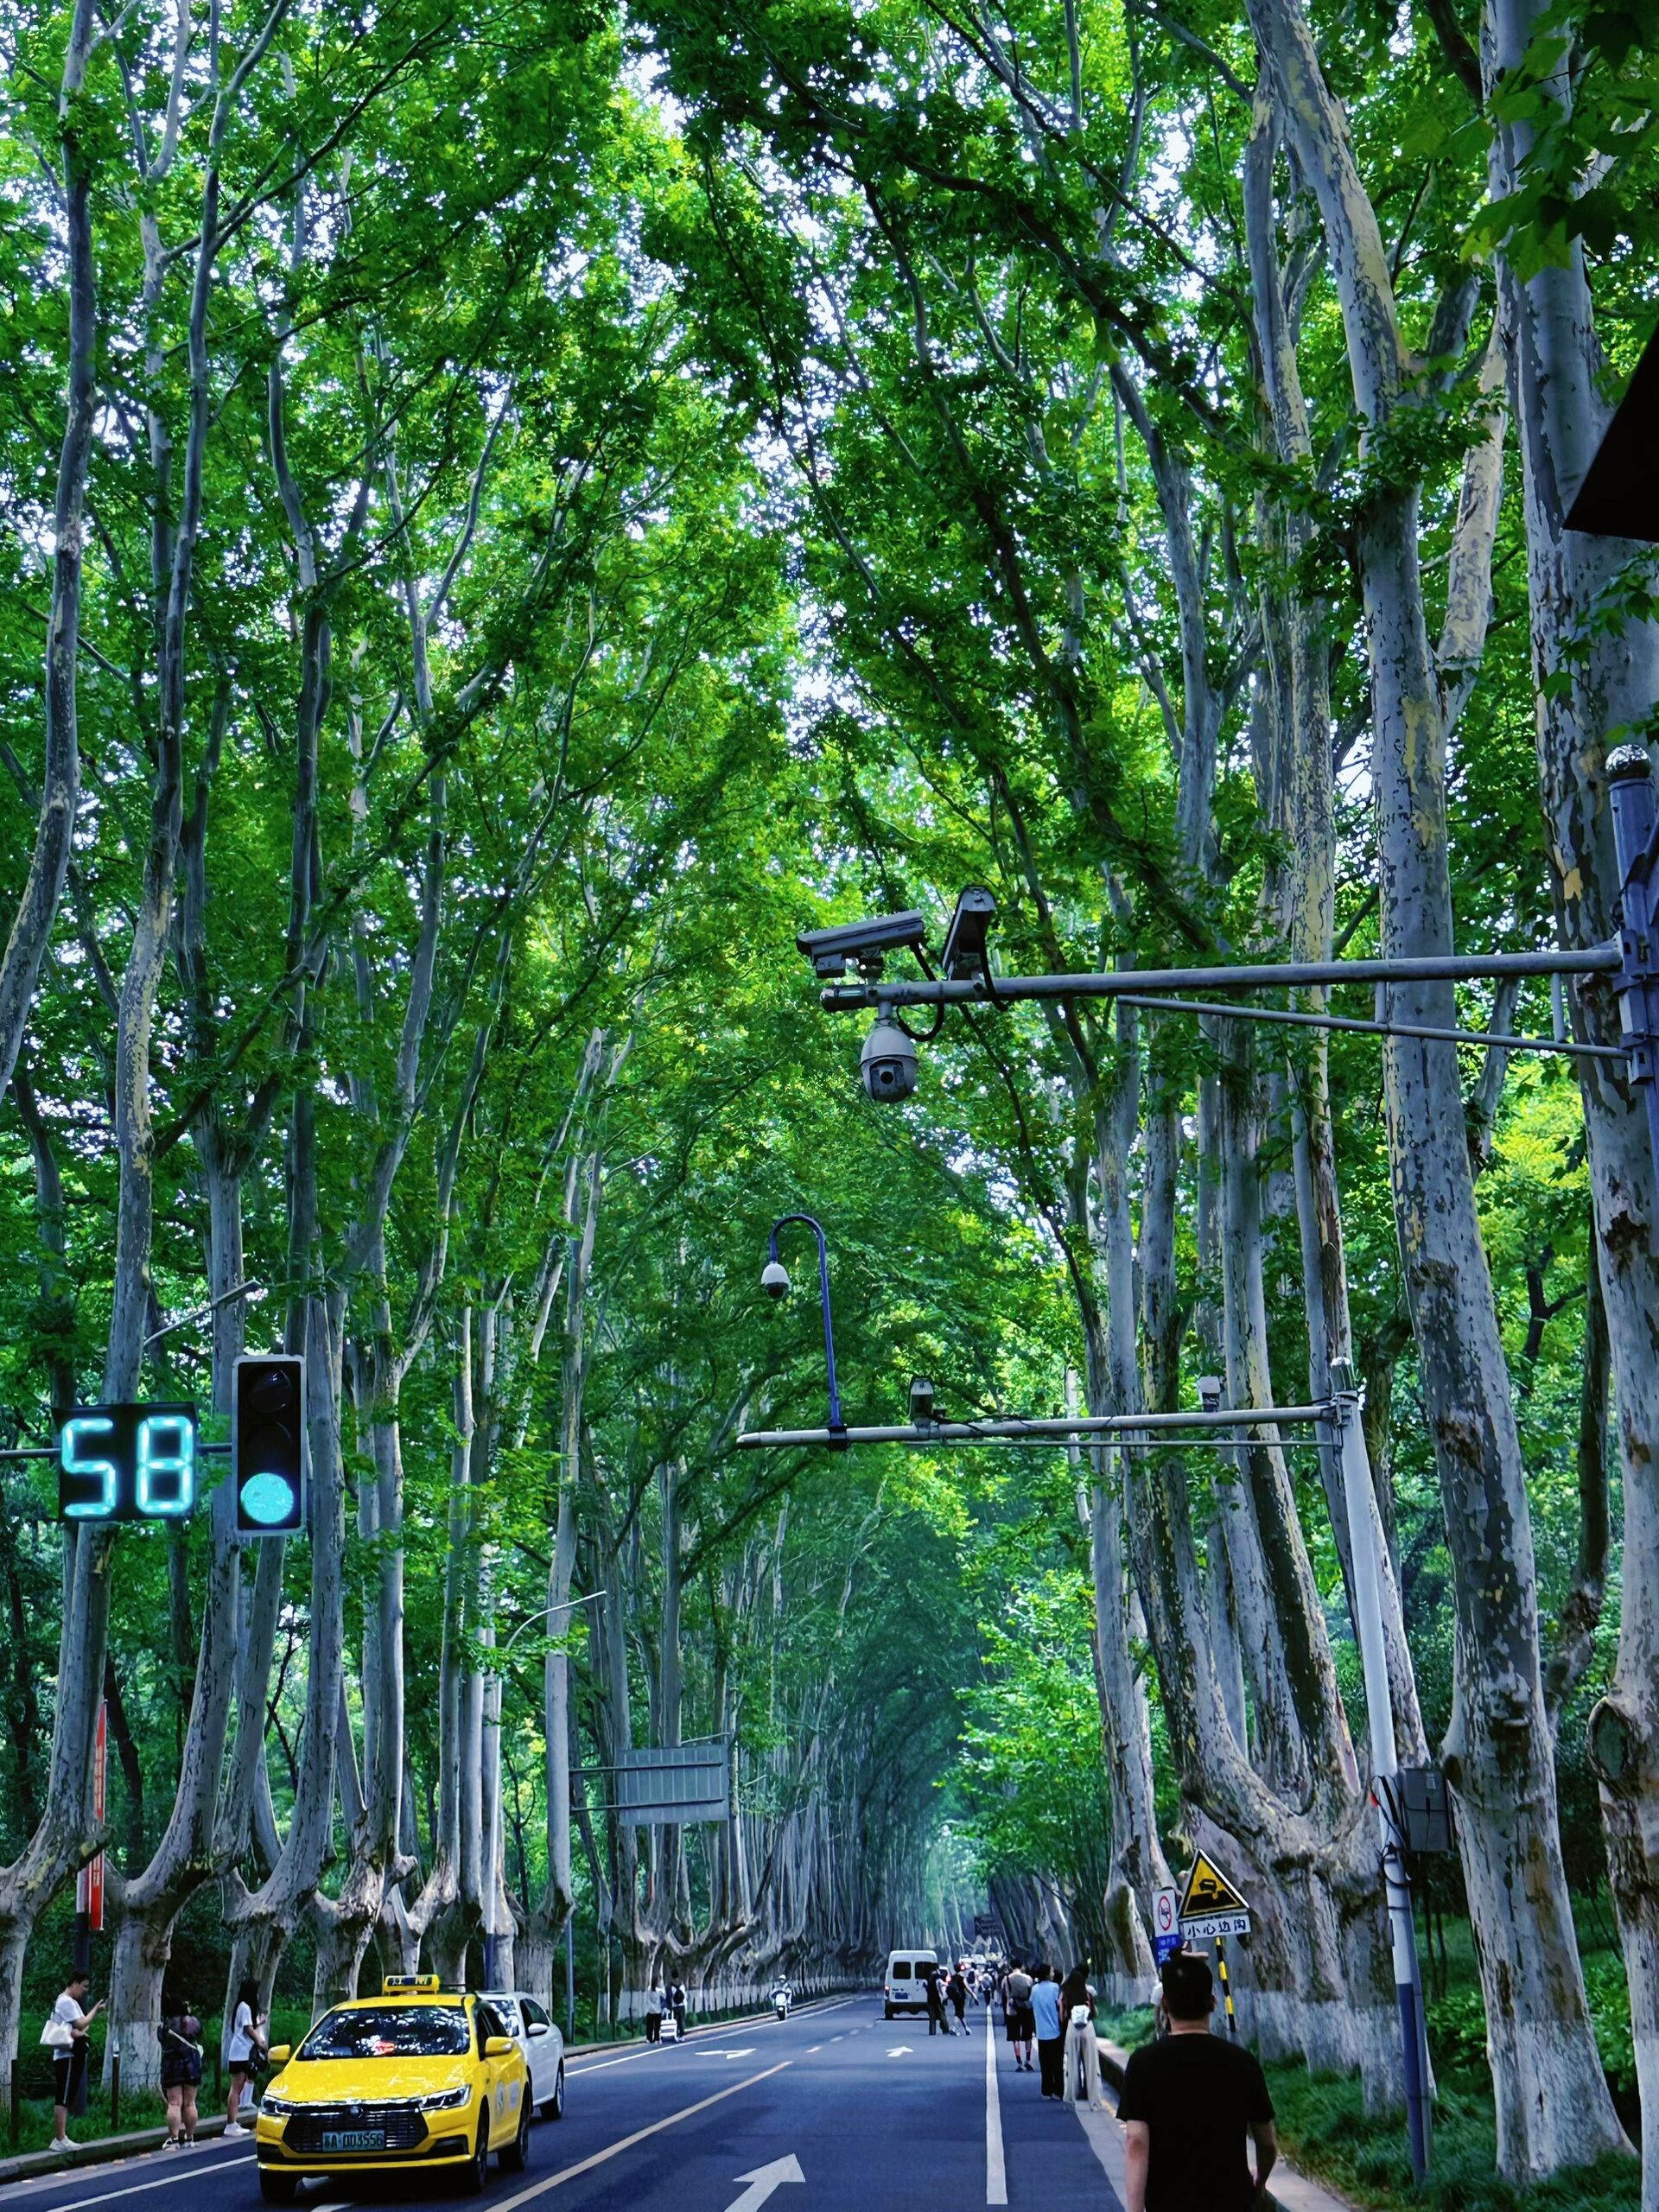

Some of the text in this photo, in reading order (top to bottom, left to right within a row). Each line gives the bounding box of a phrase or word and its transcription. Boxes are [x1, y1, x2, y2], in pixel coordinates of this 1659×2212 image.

[61, 1415, 194, 1516] 58
[1188, 1918, 1246, 1937] 小心边沟
